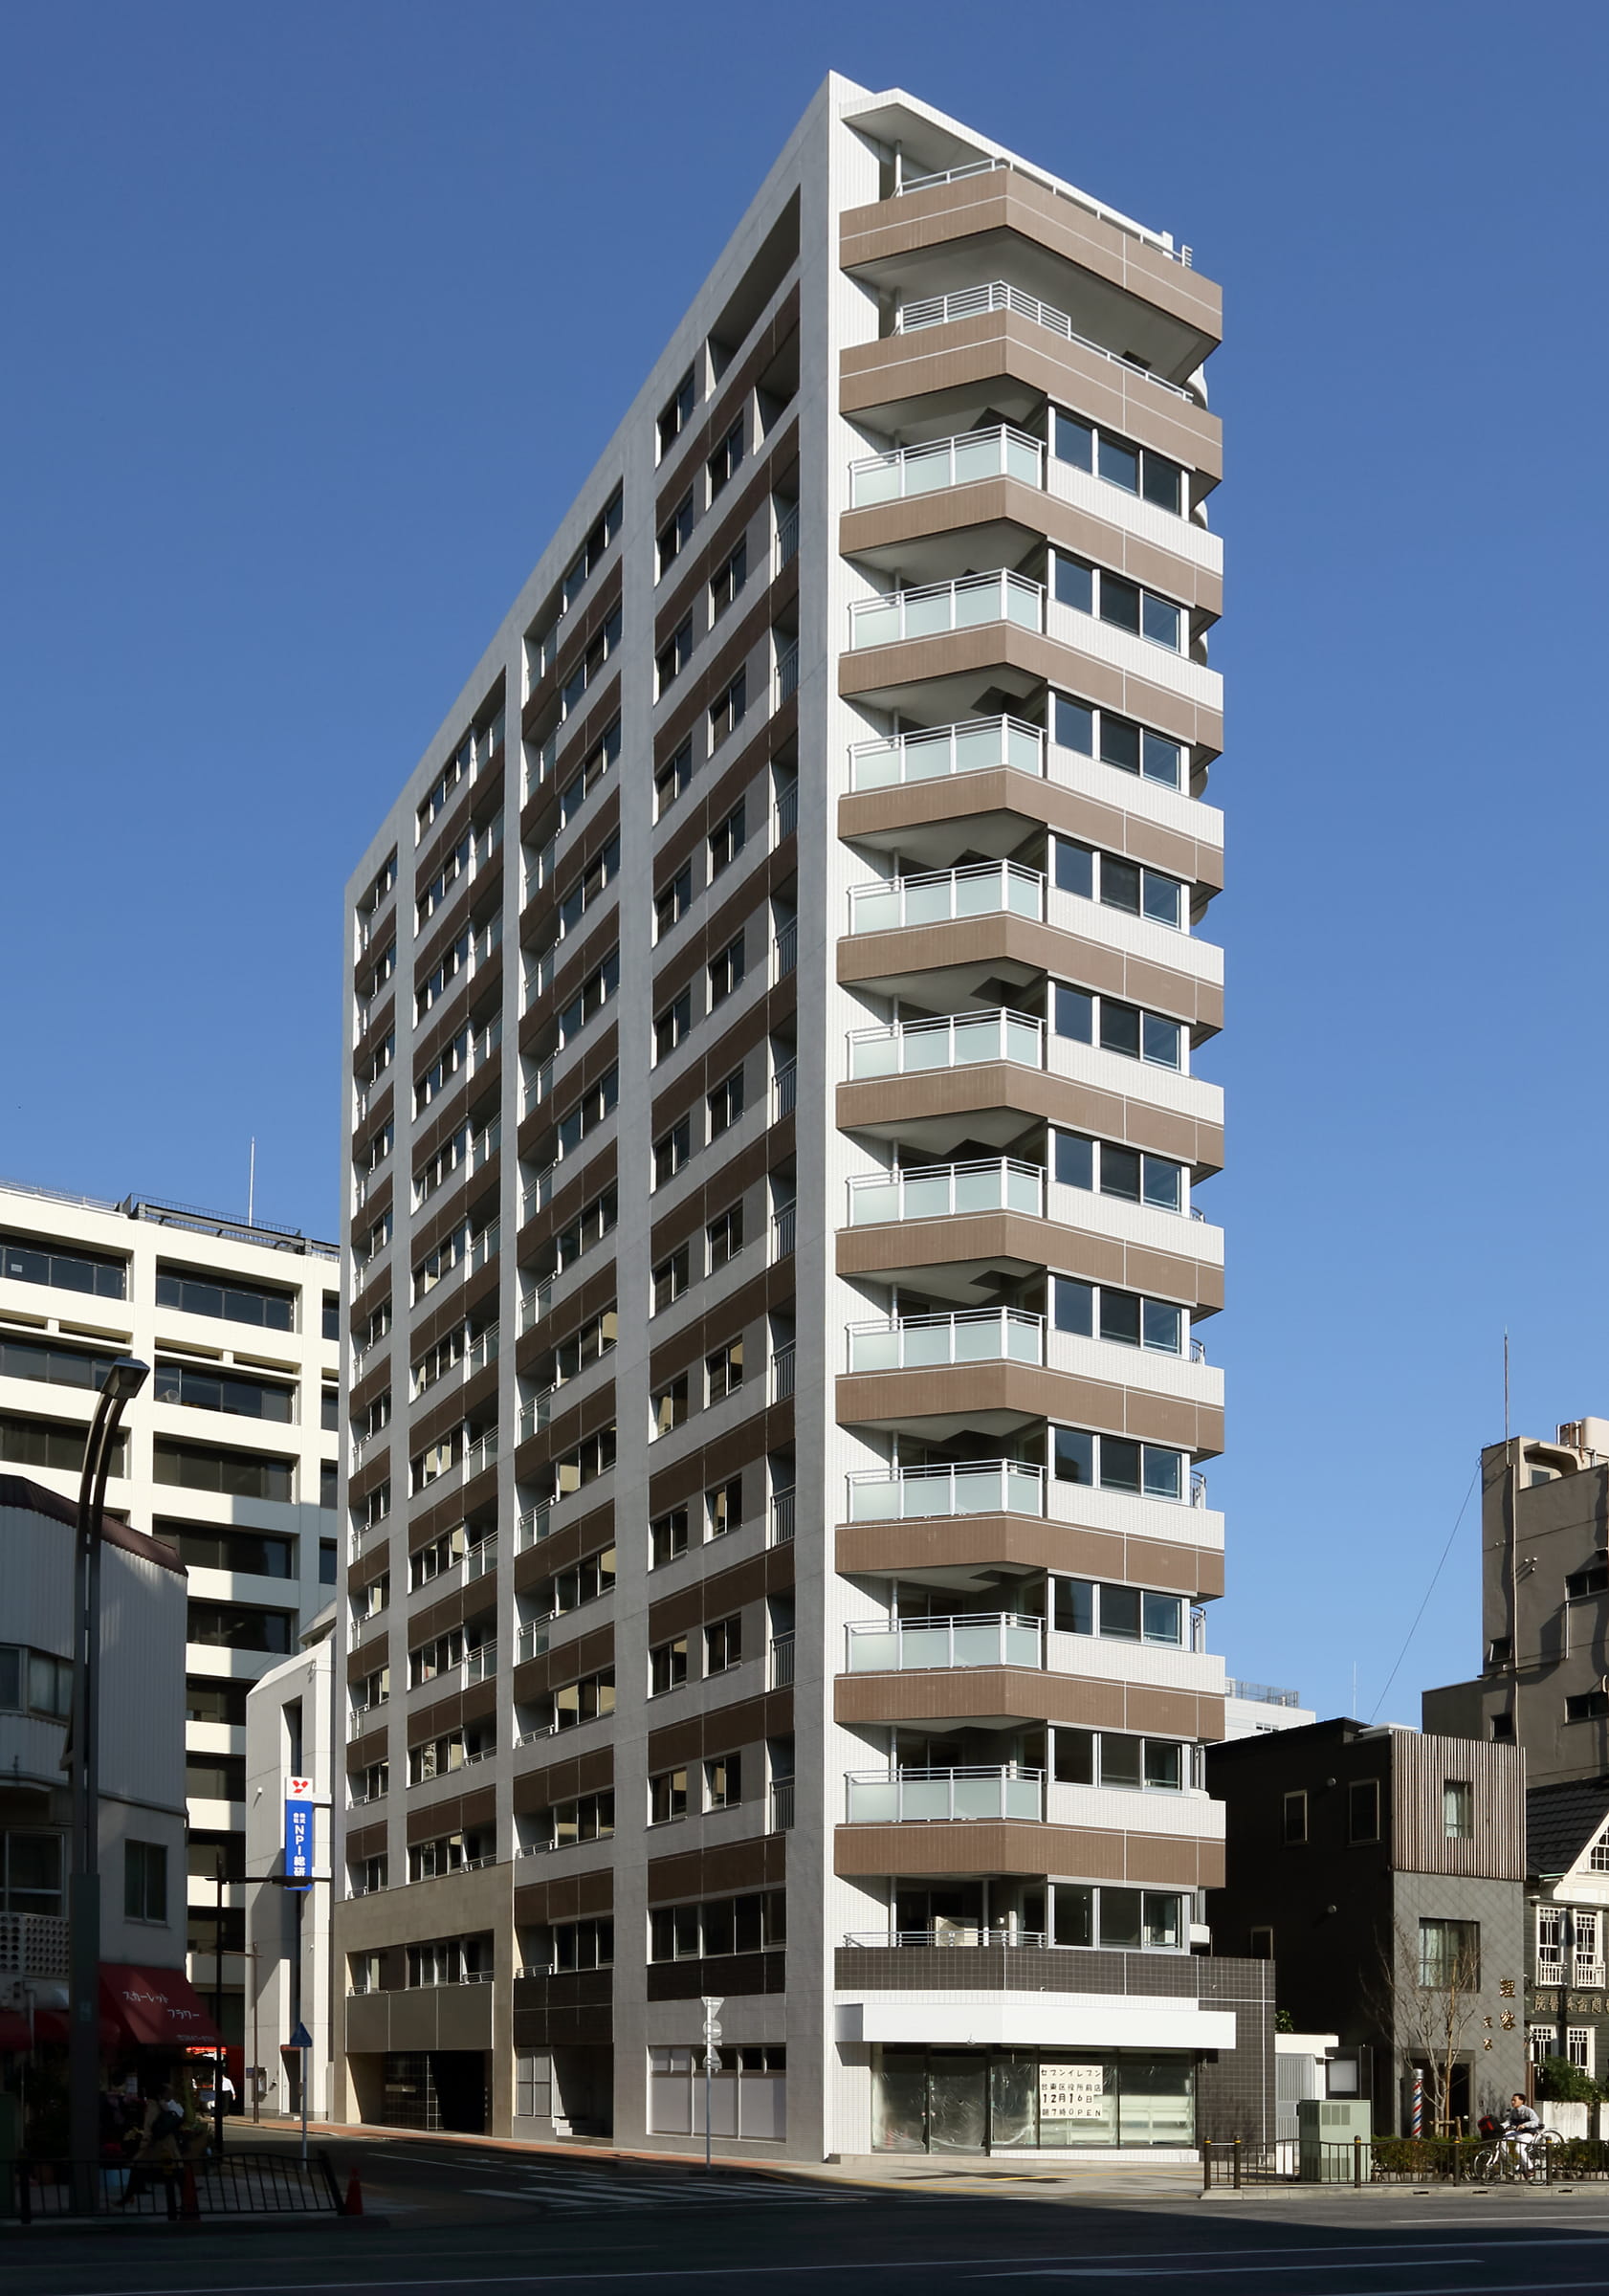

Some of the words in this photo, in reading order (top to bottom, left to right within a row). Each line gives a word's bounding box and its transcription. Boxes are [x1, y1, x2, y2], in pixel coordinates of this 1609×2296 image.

[1499, 1977, 1516, 2031] 理容
[167, 2008, 200, 2020] フラワー
[1041, 2068, 1101, 2077] セブンイレブン
[1043, 2092, 1092, 2104] 12月16日
